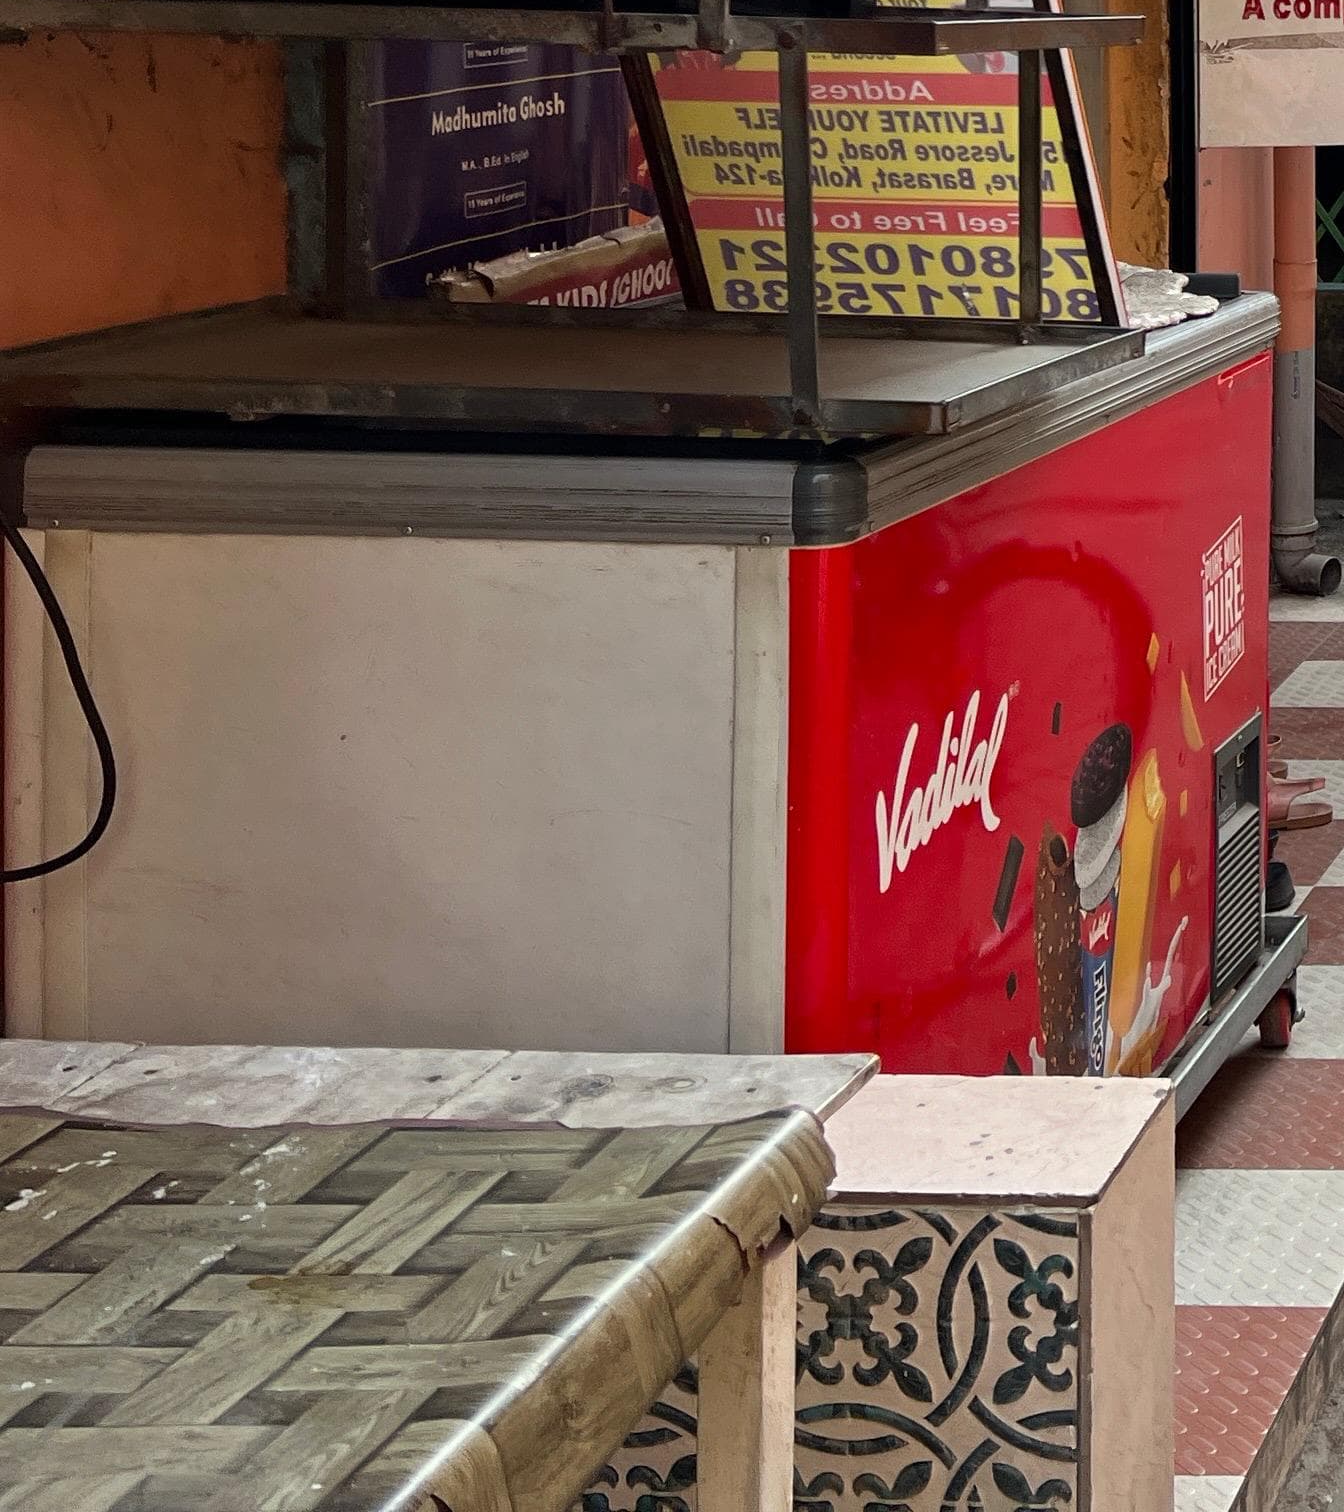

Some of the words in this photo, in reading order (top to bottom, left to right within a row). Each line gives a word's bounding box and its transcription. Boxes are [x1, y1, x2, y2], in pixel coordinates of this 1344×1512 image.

[431, 103, 517, 136] Madhumita
[519, 92, 566, 120] Ghosh
[1205, 559, 1243, 660] PURE
[876, 690, 1008, 894] Vadilal
